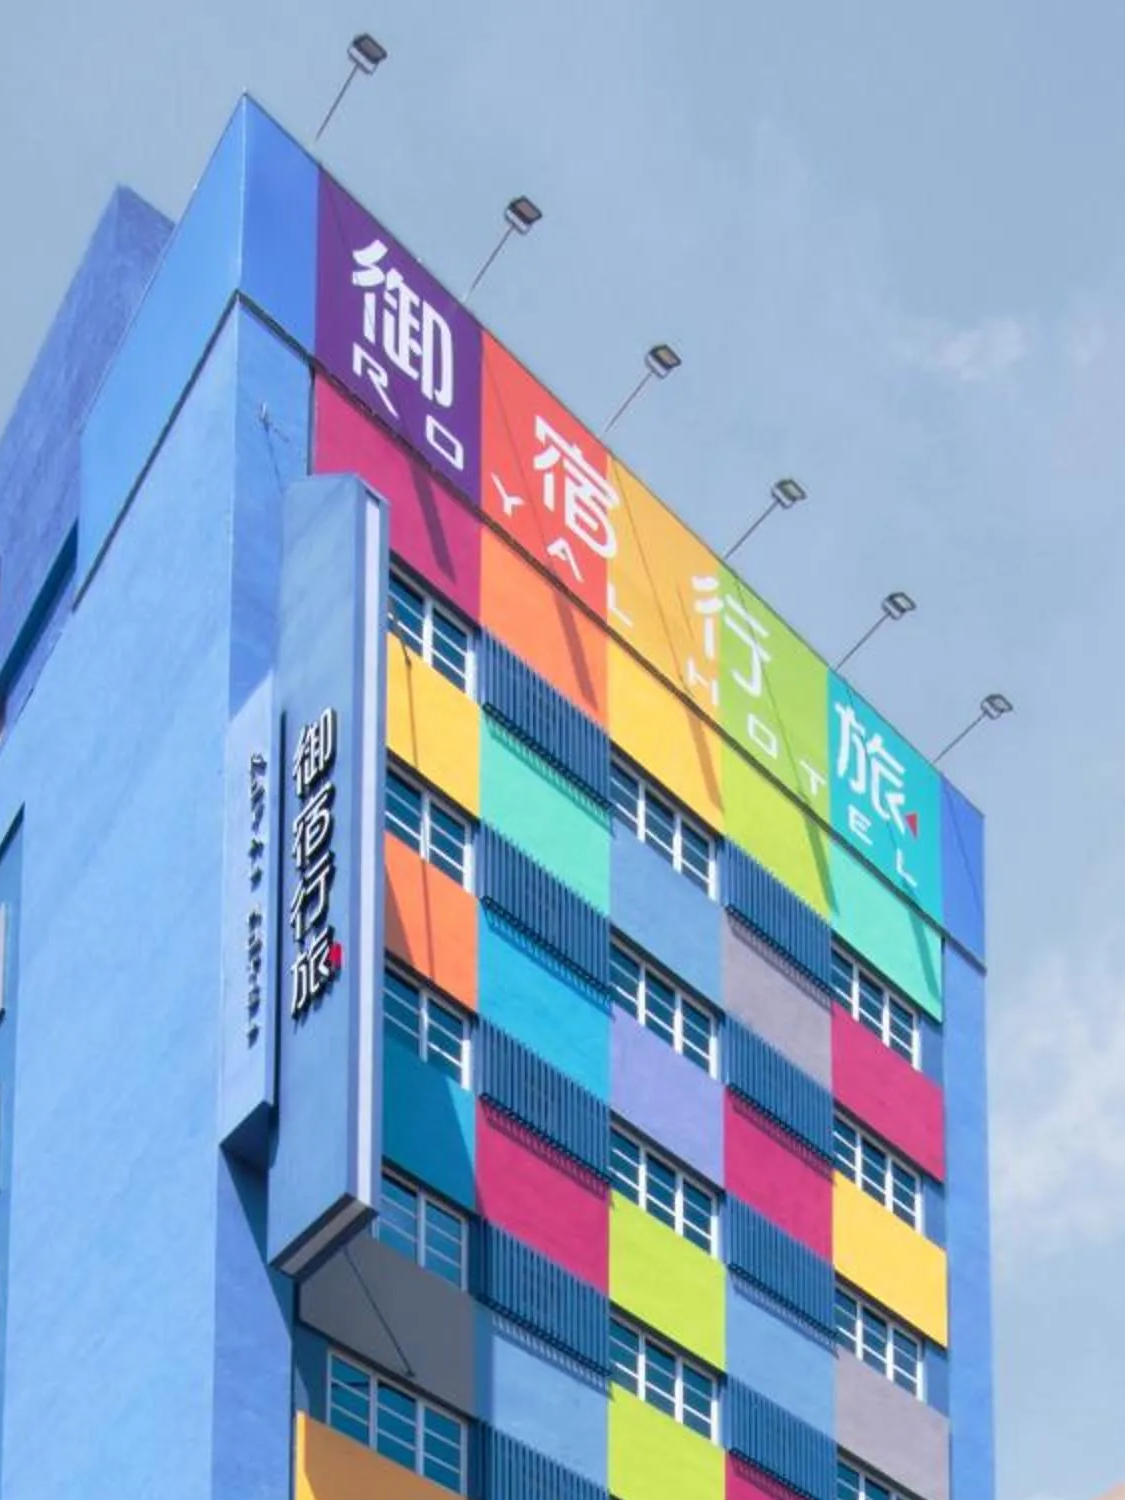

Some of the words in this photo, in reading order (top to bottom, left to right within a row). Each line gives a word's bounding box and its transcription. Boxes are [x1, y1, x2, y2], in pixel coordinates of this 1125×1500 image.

[351, 239, 907, 834] 御宿行旅
[352, 342, 633, 628] ROYAL
[687, 655, 917, 888] HOTEL
[290, 706, 337, 1022] 御宿行旅
